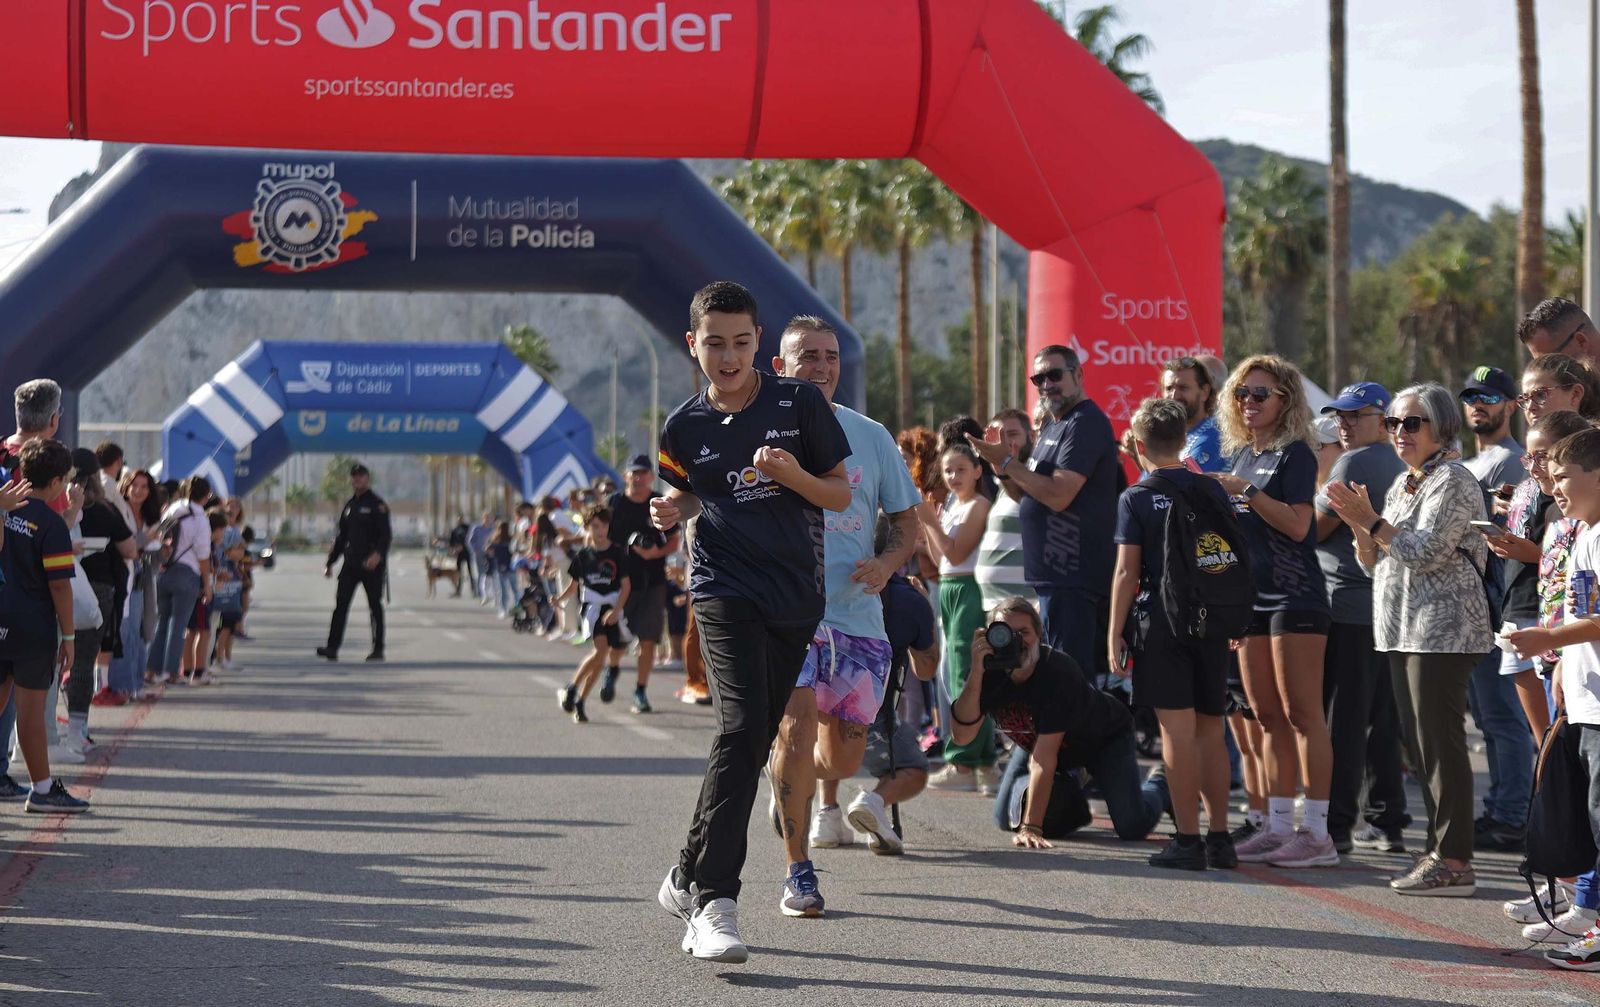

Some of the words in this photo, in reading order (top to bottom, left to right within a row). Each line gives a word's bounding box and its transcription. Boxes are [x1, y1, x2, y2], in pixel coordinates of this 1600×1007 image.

[100, 0, 303, 57] Sports
[408, 0, 733, 52] Santander
[304, 76, 515, 100] sportssantander.es
[262, 161, 336, 182] mupol
[448, 195, 580, 220] Mutualidad
[447, 224, 478, 247] de
[484, 224, 504, 247] la
[510, 224, 596, 248] Policía
[1102, 292, 1189, 325] Sports
[336, 360, 405, 378] Diputación
[414, 362, 482, 377] DEPORTES
[336, 380, 353, 395] de
[356, 378, 393, 395] Cádiz
[346, 413, 371, 433] de
[375, 414, 400, 433] La
[404, 413, 461, 433] Línea
[693, 452, 721, 465] Santander
